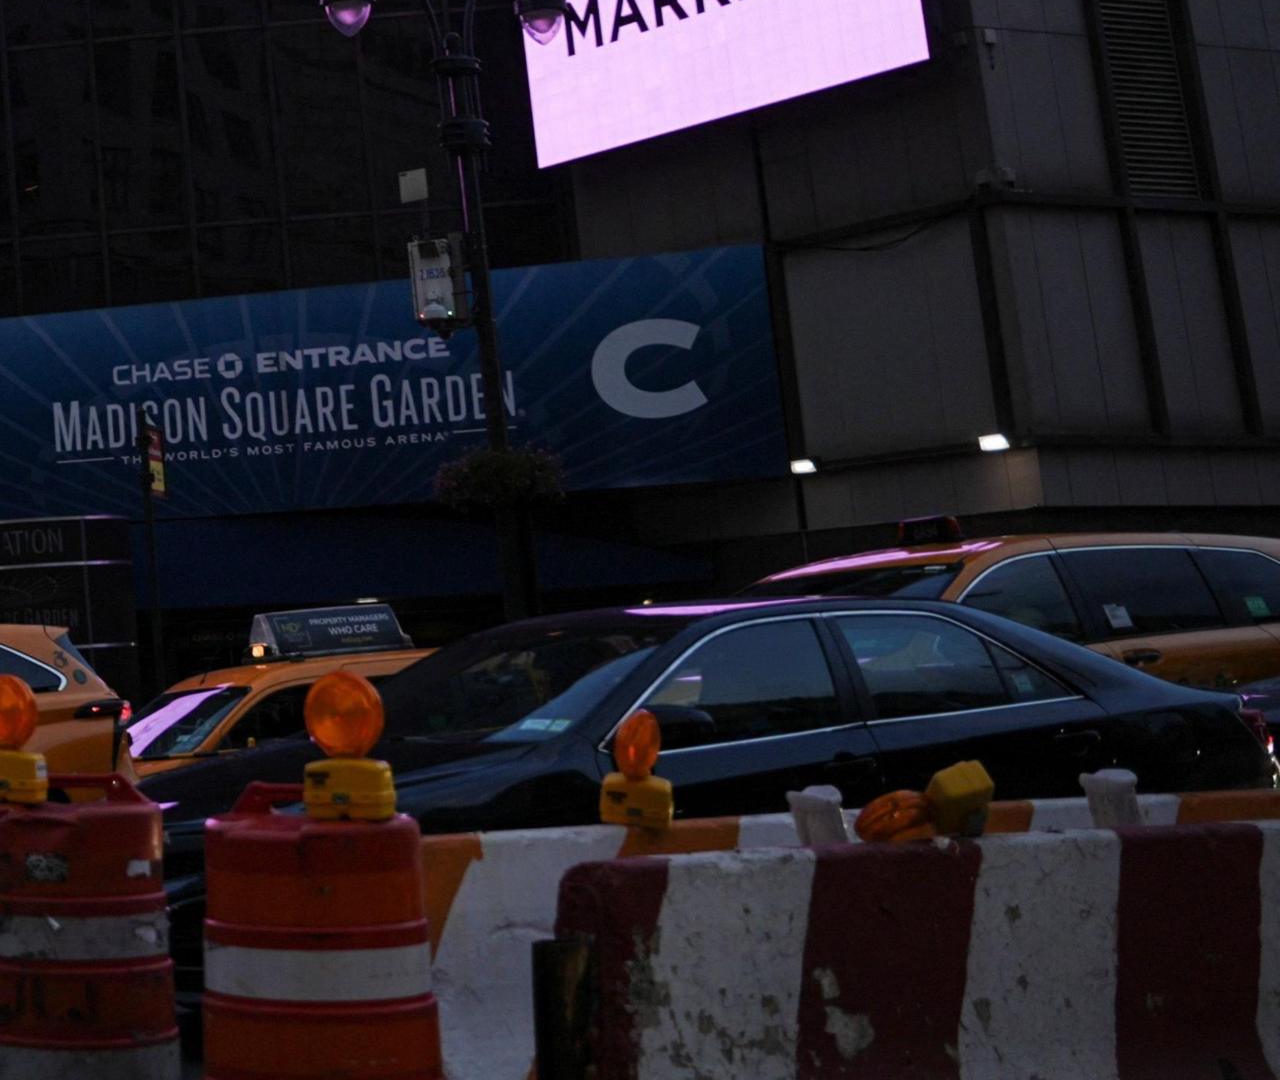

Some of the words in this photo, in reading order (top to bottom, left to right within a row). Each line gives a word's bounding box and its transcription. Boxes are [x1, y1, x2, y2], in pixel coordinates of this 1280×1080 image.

[112, 357, 212, 386] CHASE
[256, 336, 451, 373] ENTRANCE
[591, 318, 710, 419] C
[220, 383, 359, 441] SQUARE
[246, 443, 295, 457] MOST
[304, 437, 377, 452] FAMOUS
[308, 616, 347, 626] PROPERTY
[348, 613, 389, 623] MANAGERS
[328, 625, 353, 636] WHO
[354, 623, 379, 634] CARE
